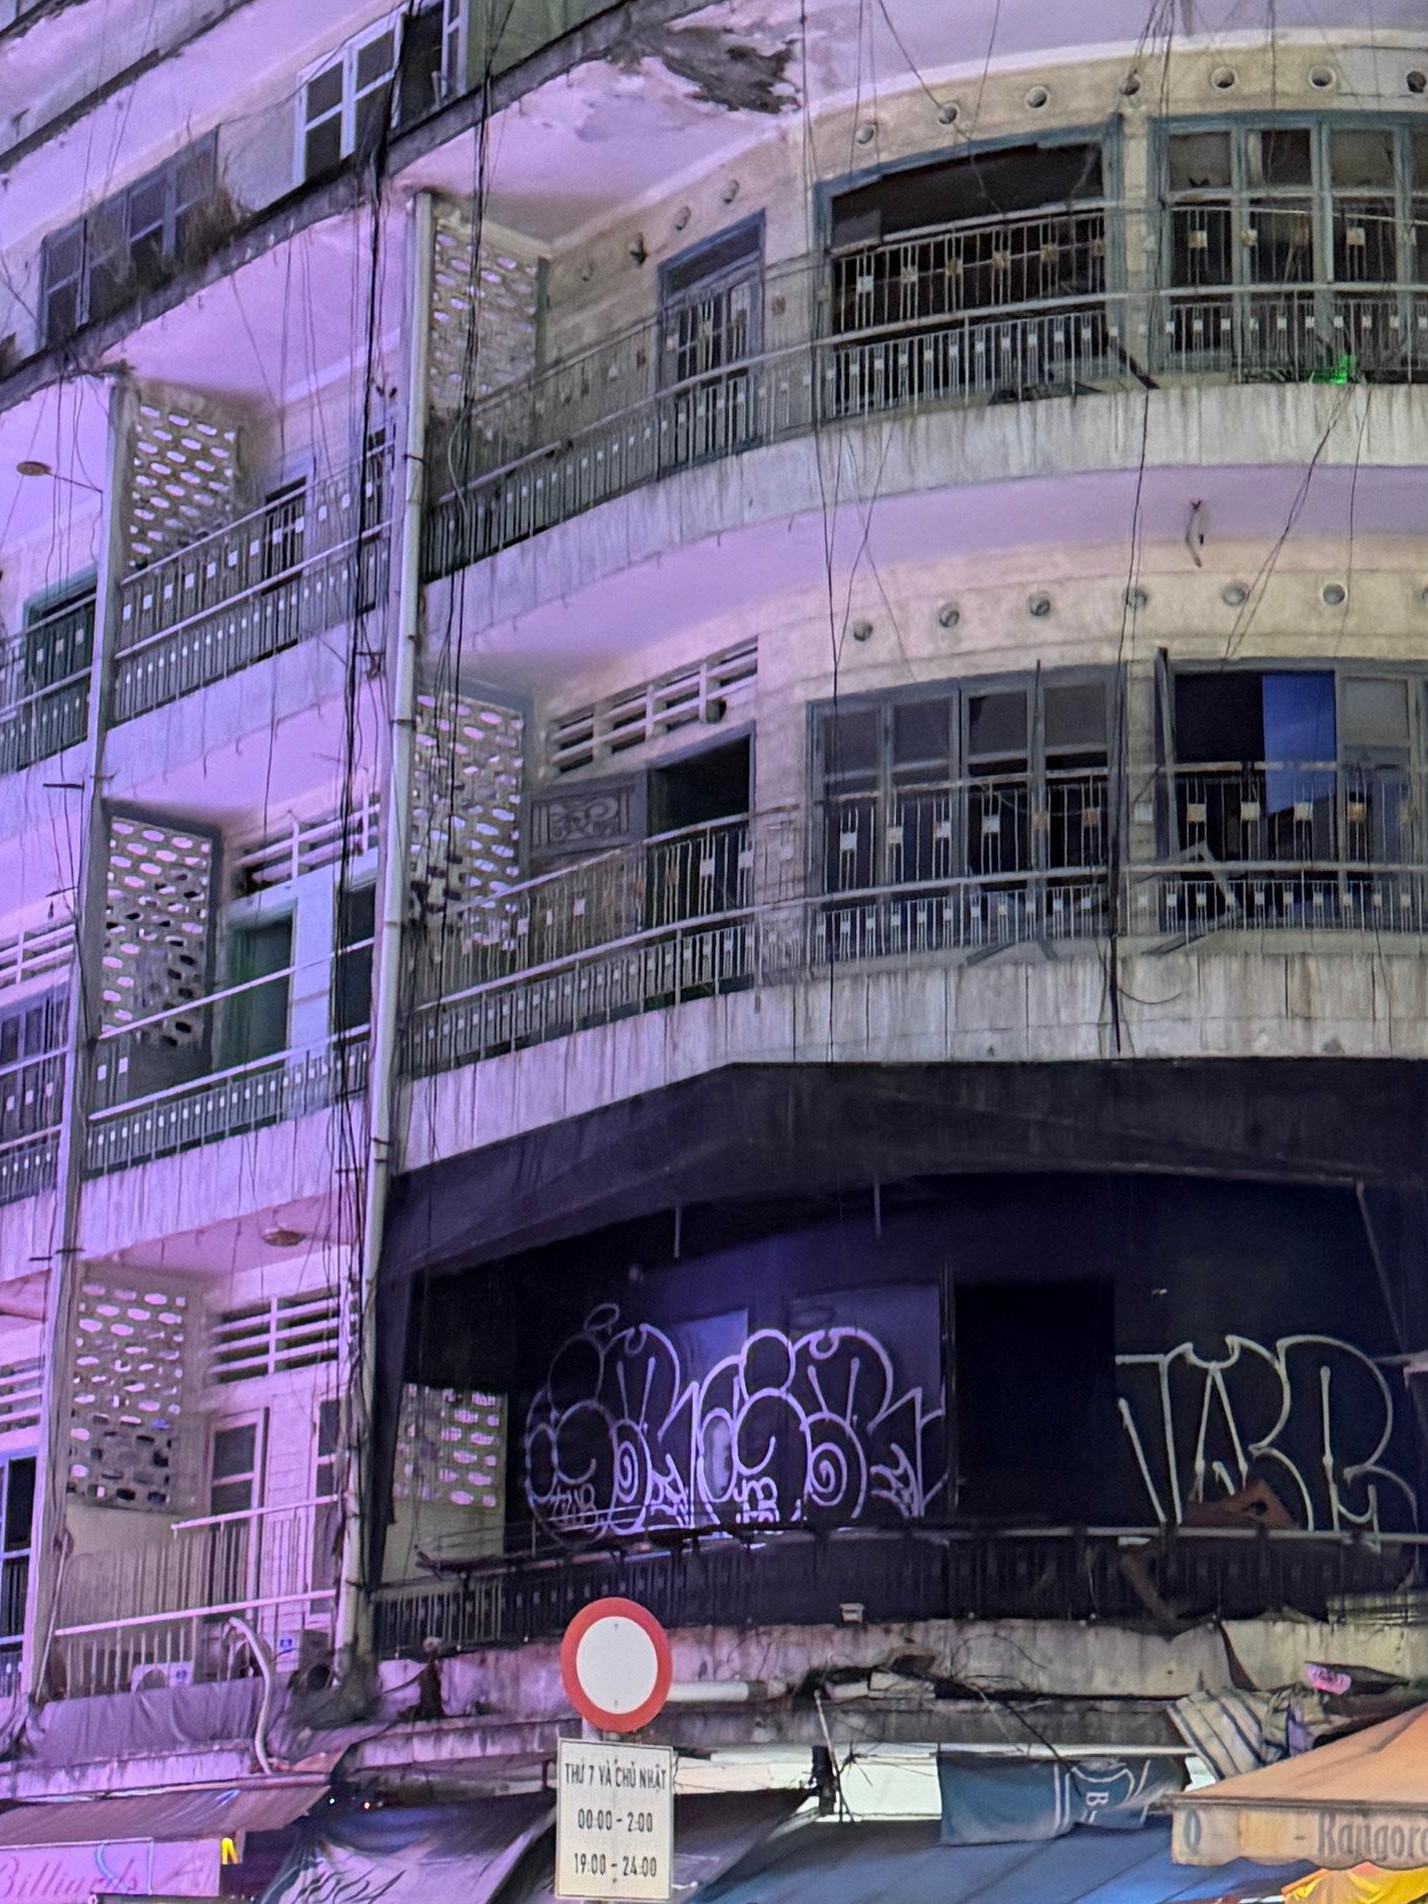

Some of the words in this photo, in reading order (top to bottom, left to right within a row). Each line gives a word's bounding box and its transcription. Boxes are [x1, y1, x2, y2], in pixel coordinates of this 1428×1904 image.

[565, 1760, 585, 1785] THỨ
[589, 1764, 594, 1785] 7
[599, 1760, 612, 1787] VÀ
[578, 1808, 613, 1831] 00:00
[627, 1812, 653, 1832] 2:00
[574, 1853, 607, 1876] 19:00
[623, 1856, 657, 1877] 24:00
